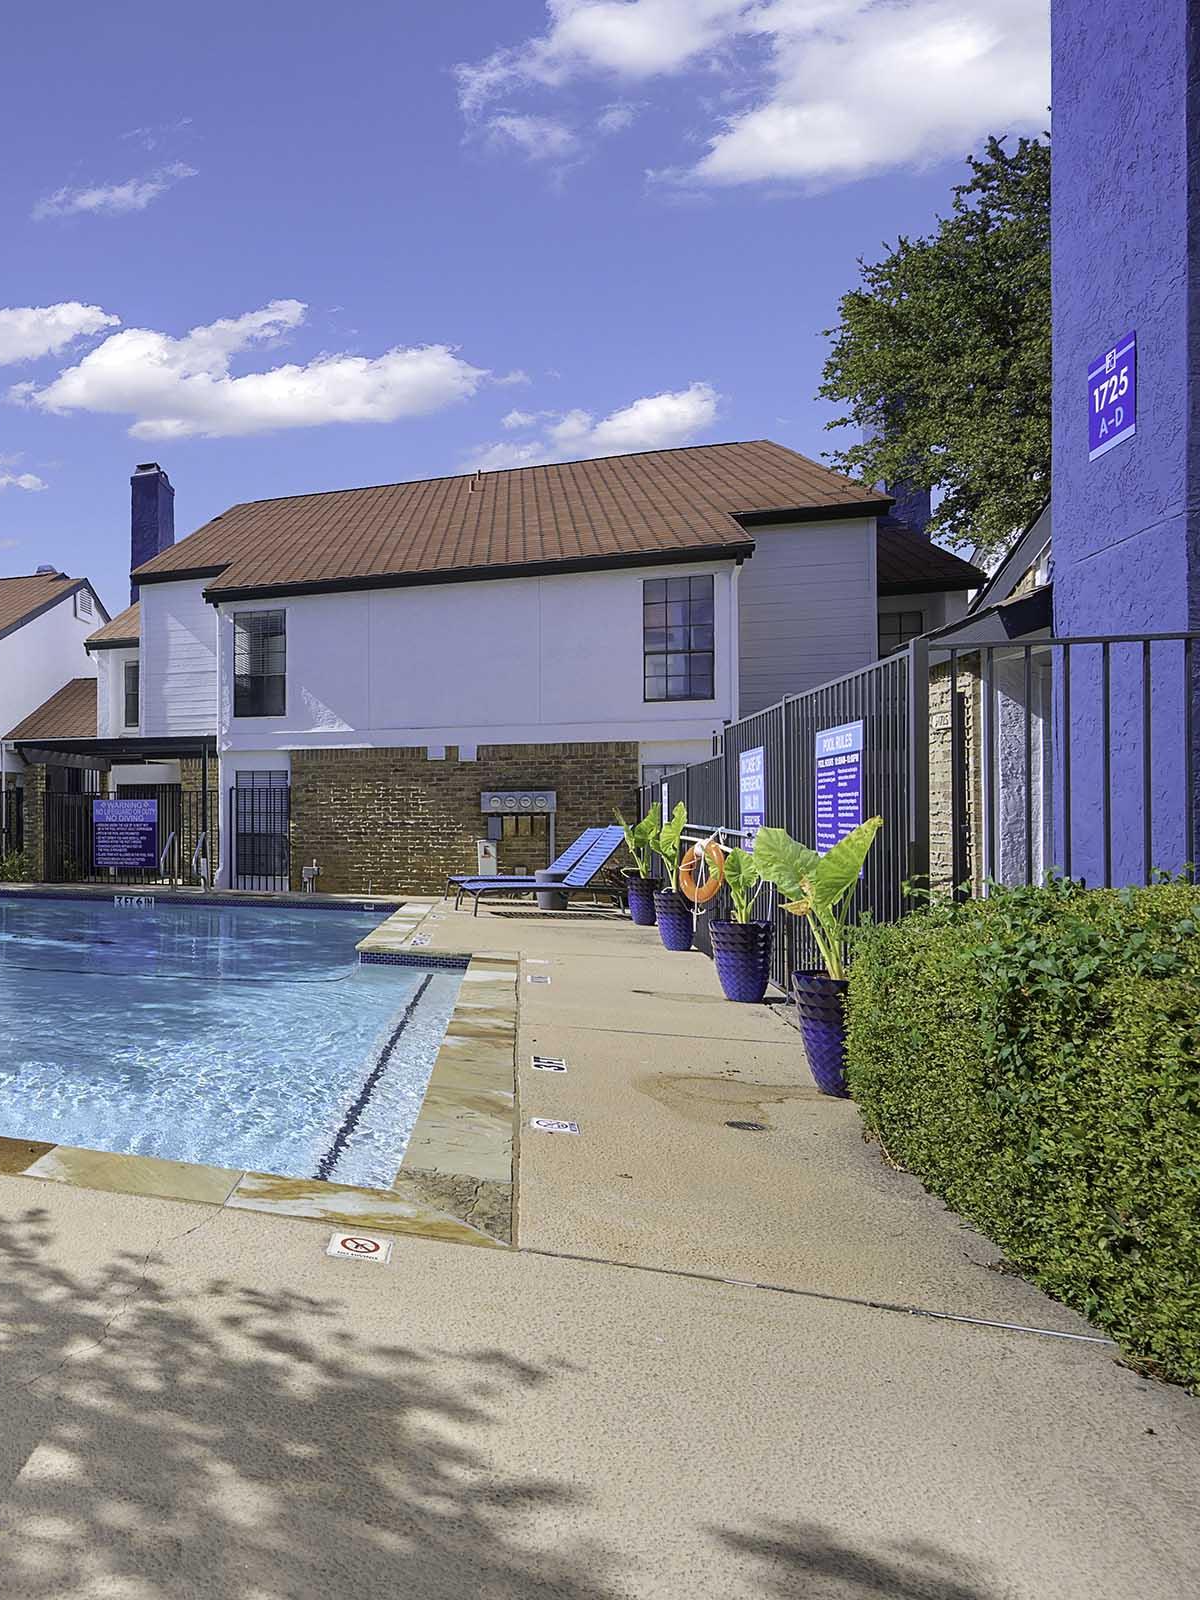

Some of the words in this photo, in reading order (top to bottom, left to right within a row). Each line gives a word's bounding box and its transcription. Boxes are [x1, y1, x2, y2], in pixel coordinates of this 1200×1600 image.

[1093, 366, 1128, 413] 1725
[1099, 406, 1124, 438] A-D
[106, 801, 142, 809] WARNING
